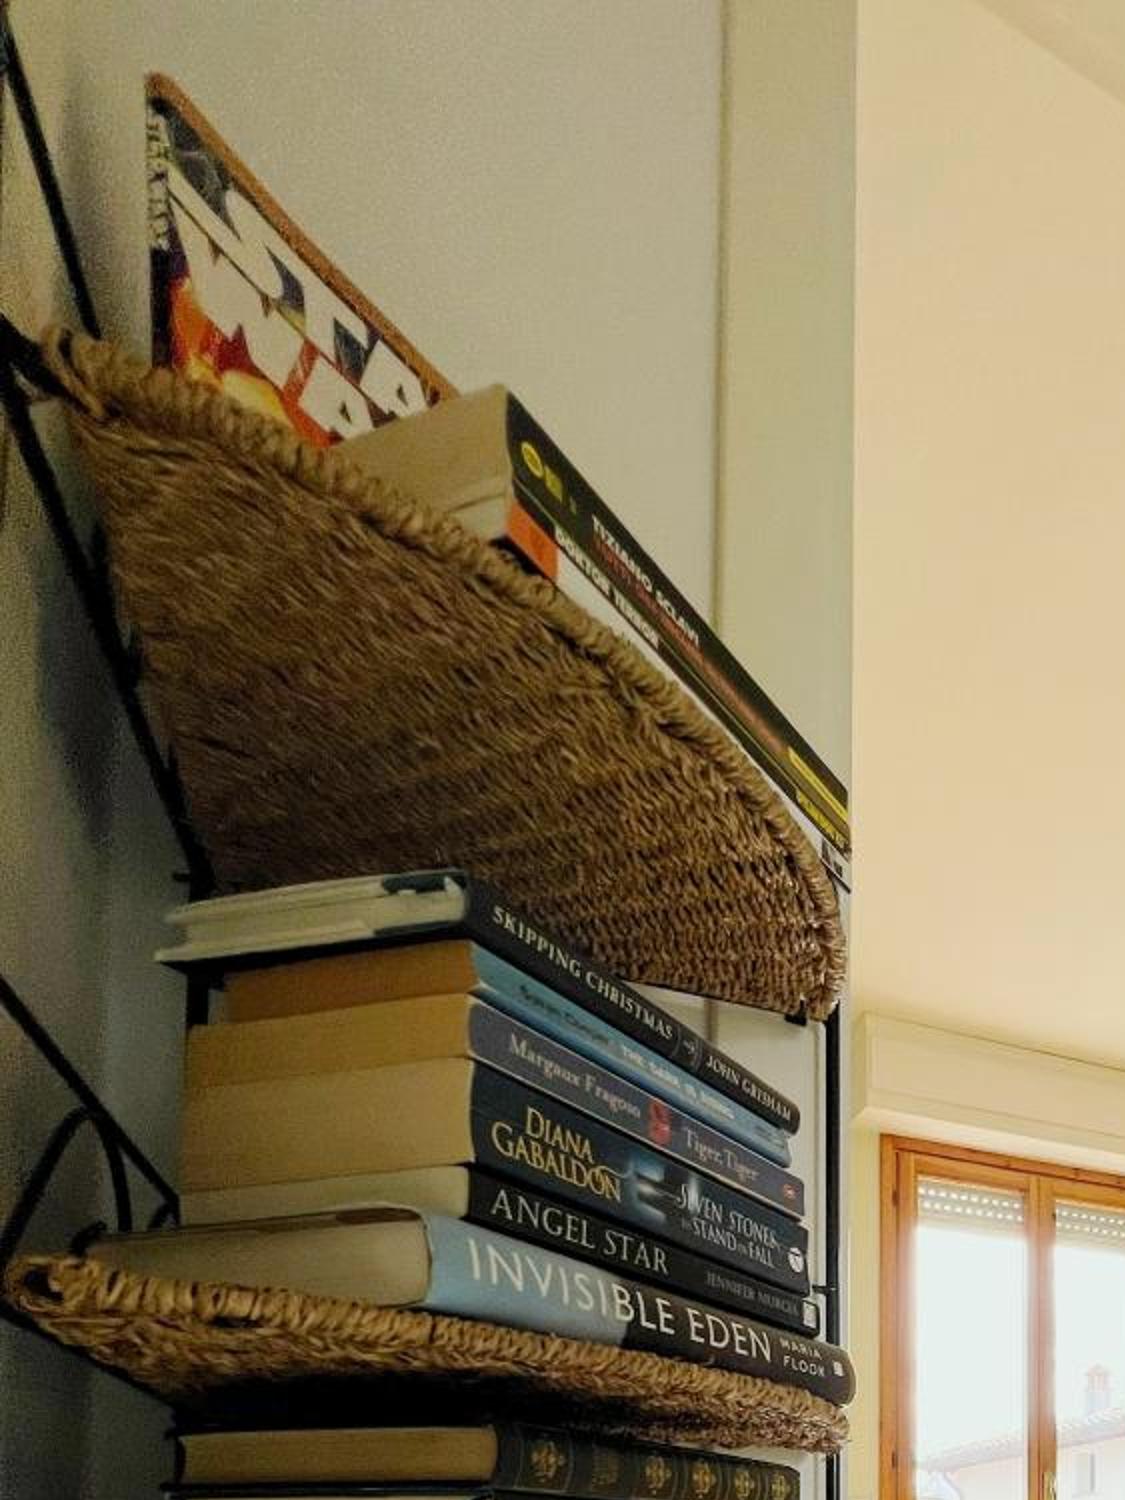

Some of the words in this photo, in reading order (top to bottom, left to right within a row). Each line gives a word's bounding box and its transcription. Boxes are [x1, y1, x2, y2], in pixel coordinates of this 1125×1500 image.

[491, 905, 582, 980] SKIPPING
[585, 970, 675, 1041] CHRISTMAS
[705, 1054, 741, 1090] JOHN
[741, 1078, 793, 1123] GRISHAM
[509, 1032, 582, 1088] Margaux
[584, 1072, 642, 1119] Fragoso
[490, 1120, 623, 1203] GABALDON
[525, 1104, 595, 1165] DIANA
[490, 1189, 597, 1251] ANGEL
[603, 1228, 670, 1276] STAR
[692, 1217, 738, 1252] STAND
[748, 1240, 776, 1269] FALL
[728, 1210, 781, 1254] STONES
[466, 1237, 676, 1337] INVISIBLE
[687, 1305, 772, 1364] EDEN
[779, 1337, 823, 1361] MARIA
[783, 1355, 825, 1377] FLOOK
